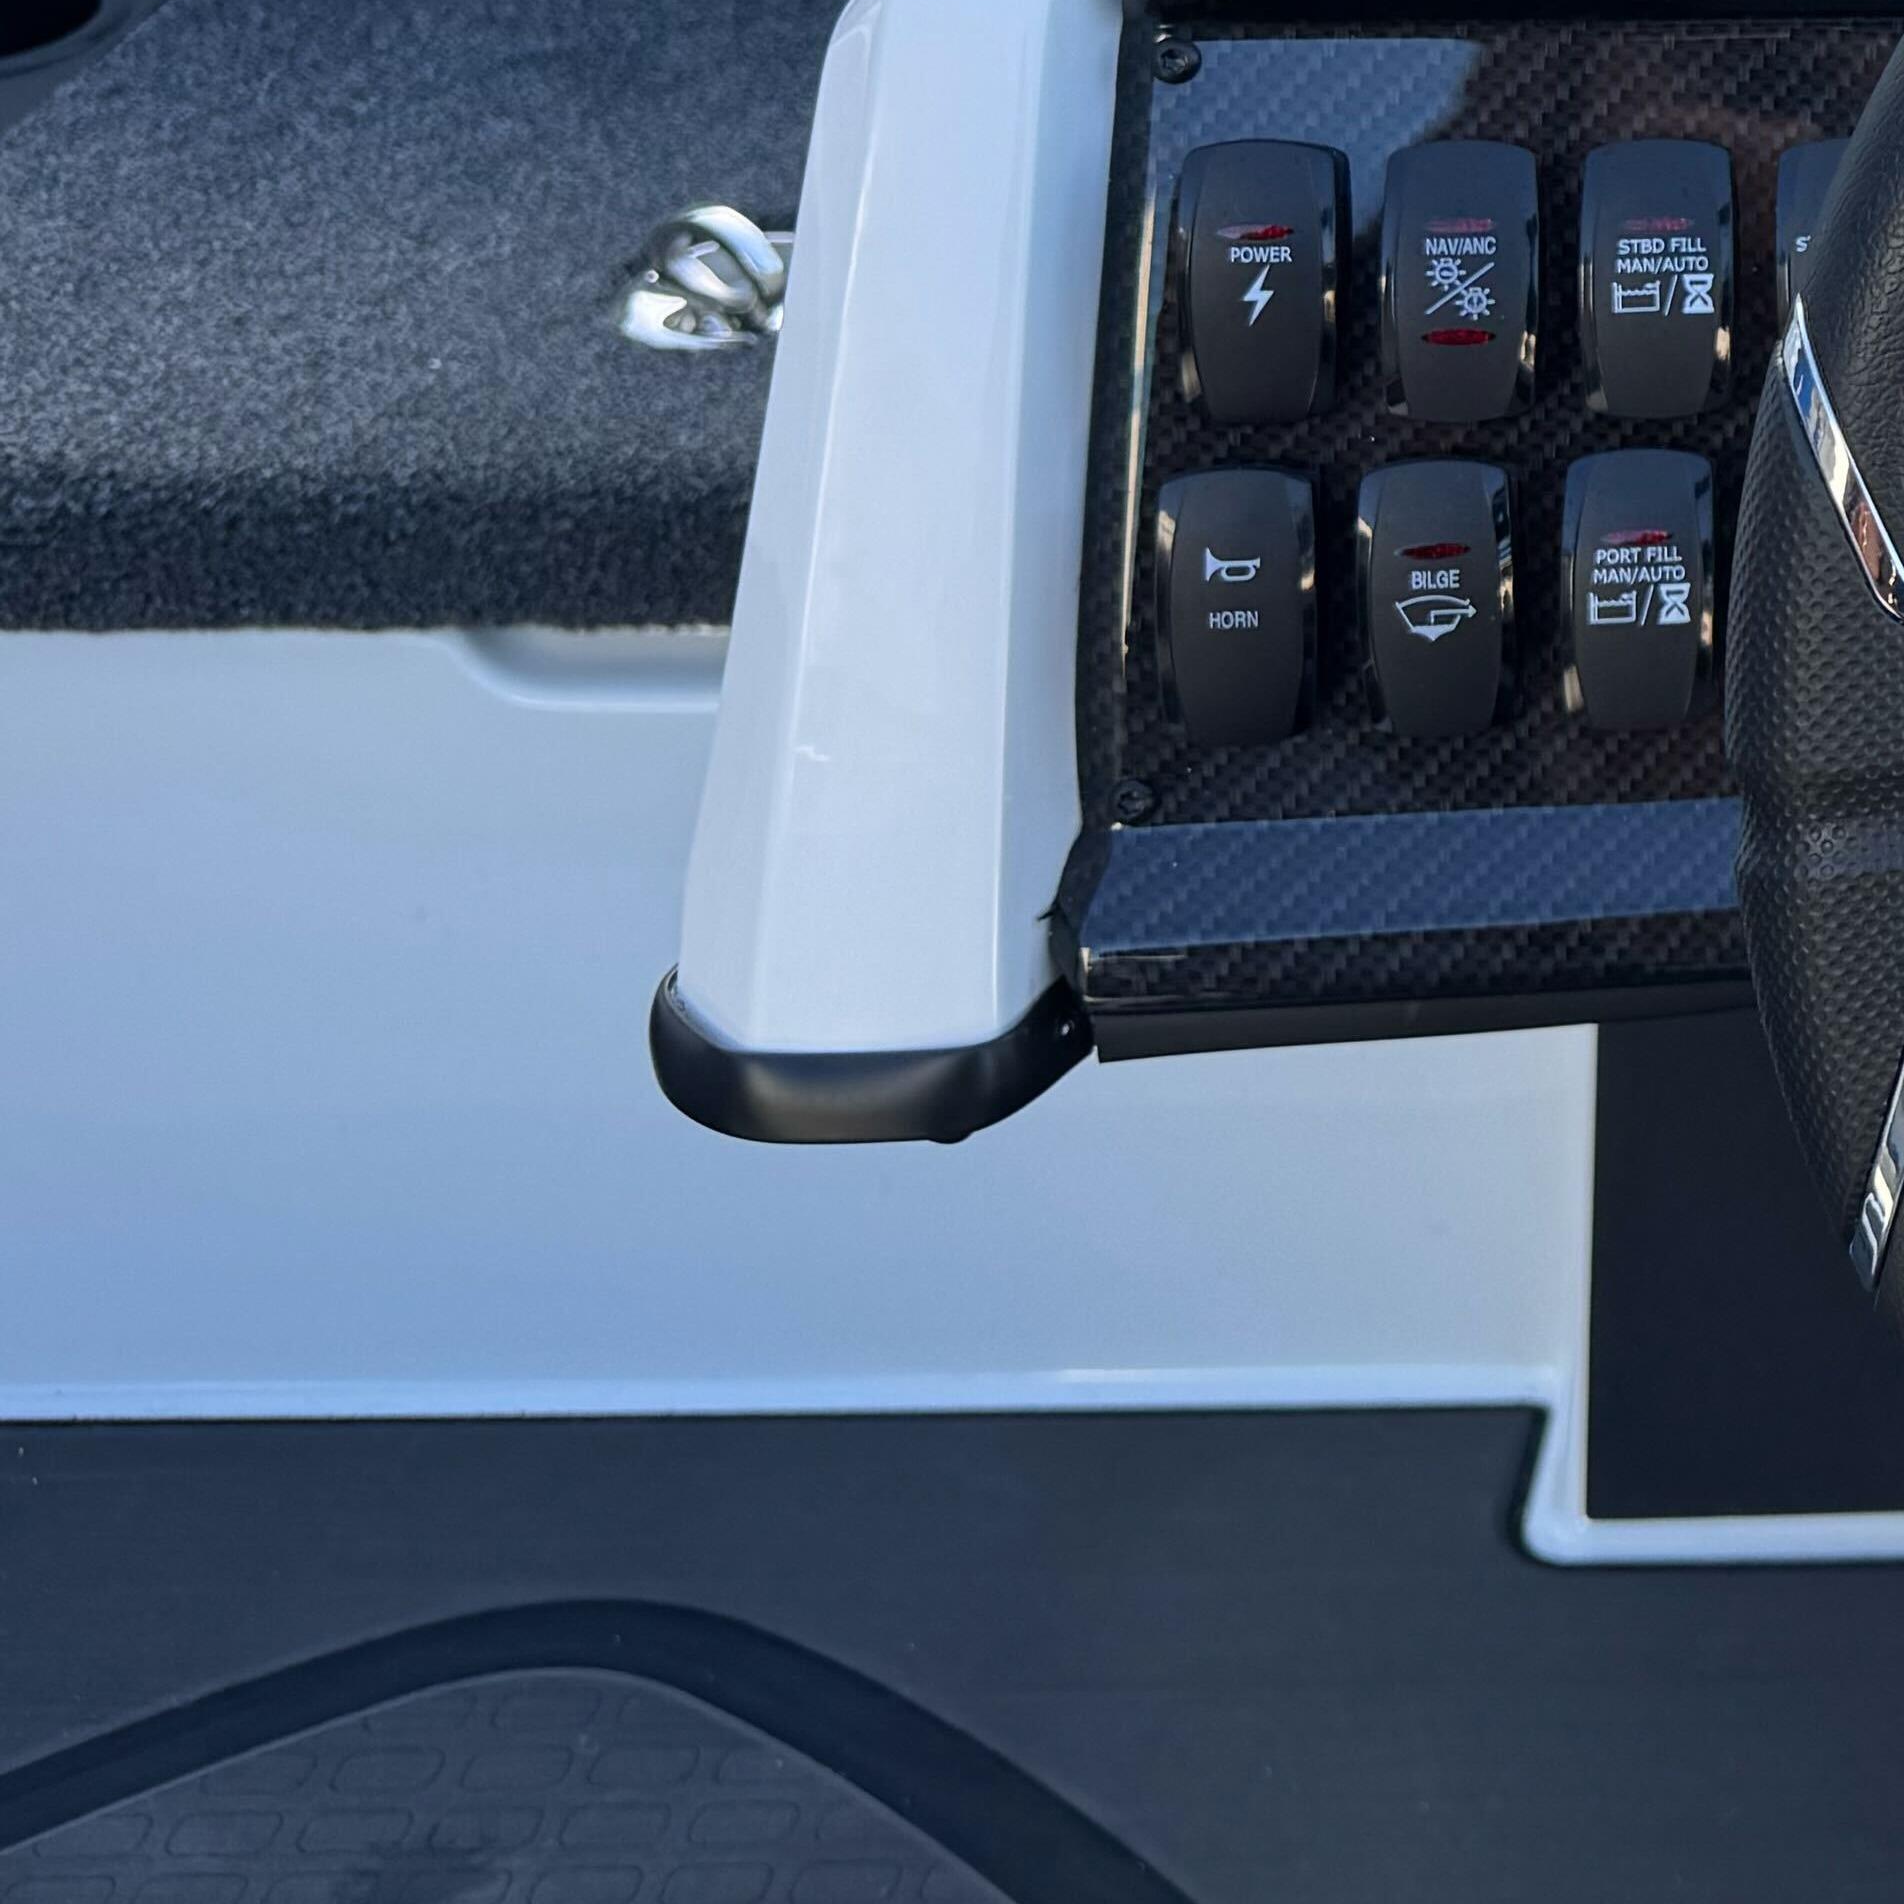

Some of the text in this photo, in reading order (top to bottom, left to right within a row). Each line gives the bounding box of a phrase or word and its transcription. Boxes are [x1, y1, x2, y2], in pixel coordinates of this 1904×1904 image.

[1230, 245, 1293, 264] POWER
[1424, 236, 1497, 257] NAV/ANC
[1617, 237, 1708, 255] STBD FILL
[1617, 255, 1710, 274] MAN/AUTO
[1595, 546, 1683, 565] PORT FILL
[1411, 569, 1461, 590] BILGE
[1592, 564, 1686, 585] MAN/AUTO
[1208, 610, 1260, 629] HORN
